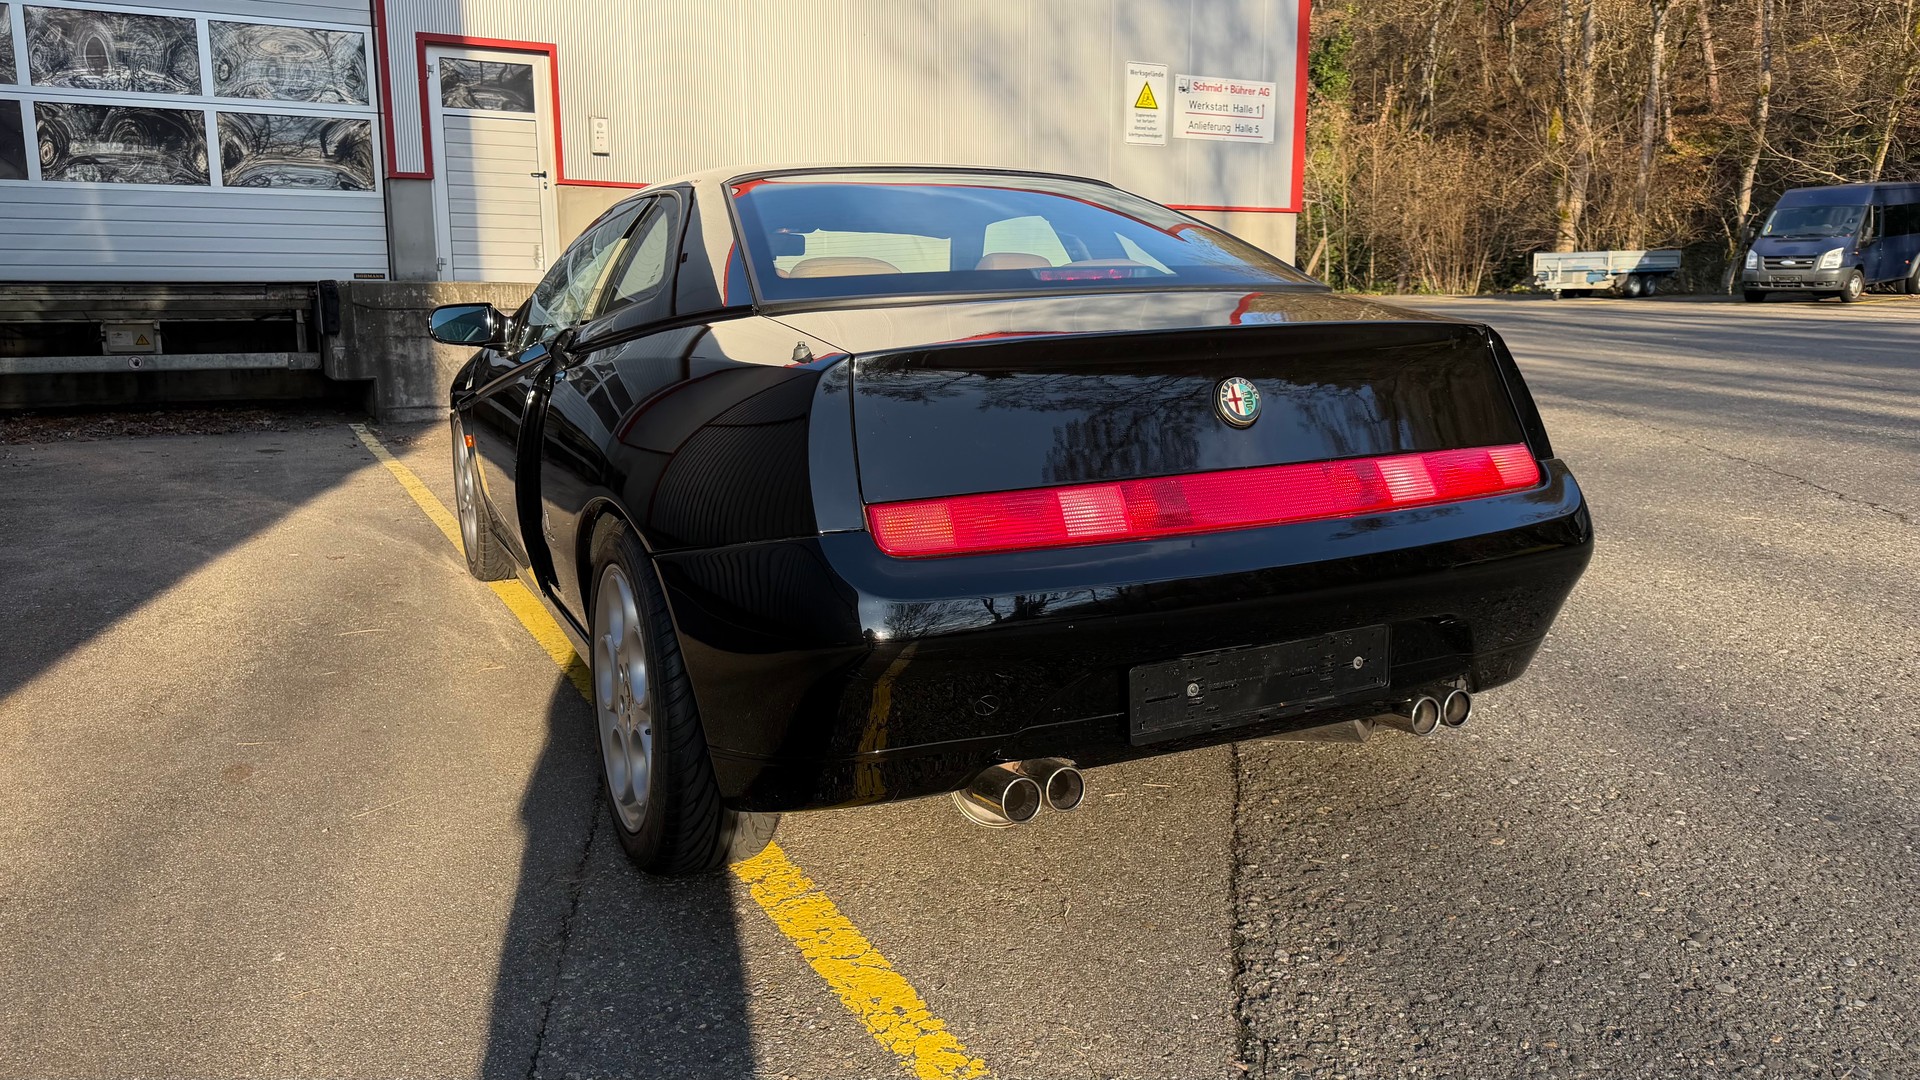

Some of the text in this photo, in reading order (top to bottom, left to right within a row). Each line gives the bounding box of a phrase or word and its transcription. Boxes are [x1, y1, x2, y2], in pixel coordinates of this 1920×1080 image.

[1130, 69, 1164, 78] Werksgelände
[1193, 81, 1222, 93] Schmid
[1230, 84, 1256, 96] Bührer
[1258, 87, 1270, 97] AG
[1189, 100, 1260, 114] Werkstatt Halle 1
[1188, 120, 1260, 134] Anlieferung Halle 5
